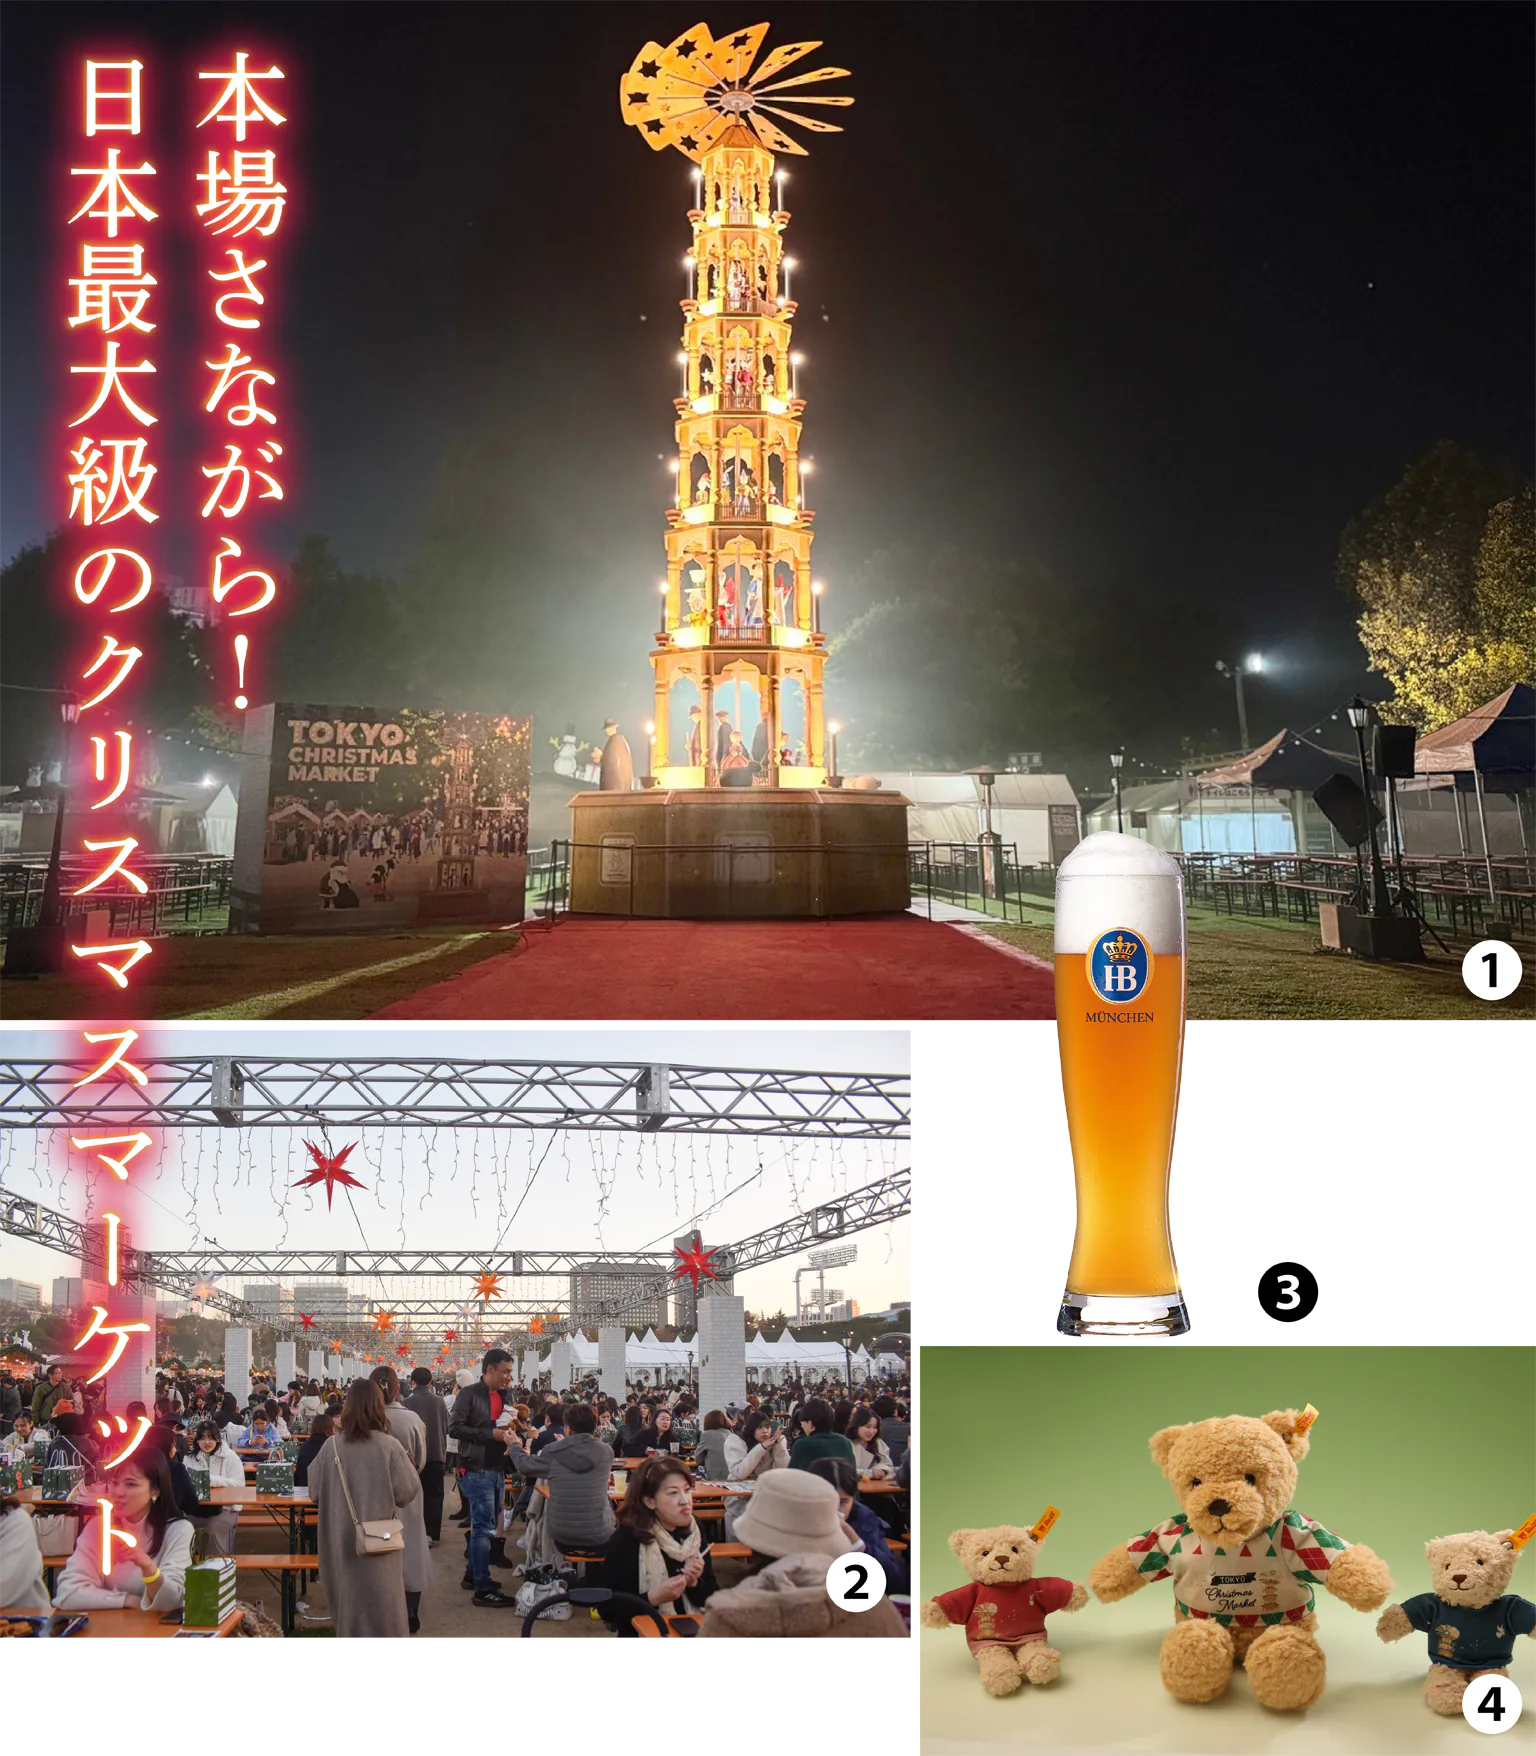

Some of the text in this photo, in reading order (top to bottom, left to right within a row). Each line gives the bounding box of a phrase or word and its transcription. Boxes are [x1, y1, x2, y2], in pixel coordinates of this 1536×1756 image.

[287, 719, 404, 747] TOKYO
[287, 746, 417, 765] CHRISTMAS
[287, 765, 380, 782] MARKET
[1103, 965, 1138, 992] HB
[1085, 1010, 1155, 1023] MÜNCHEN
[1219, 1575, 1246, 1584] TOKYO
[1204, 1587, 1254, 1601] Christmas
[1216, 1598, 1257, 1612] Market
